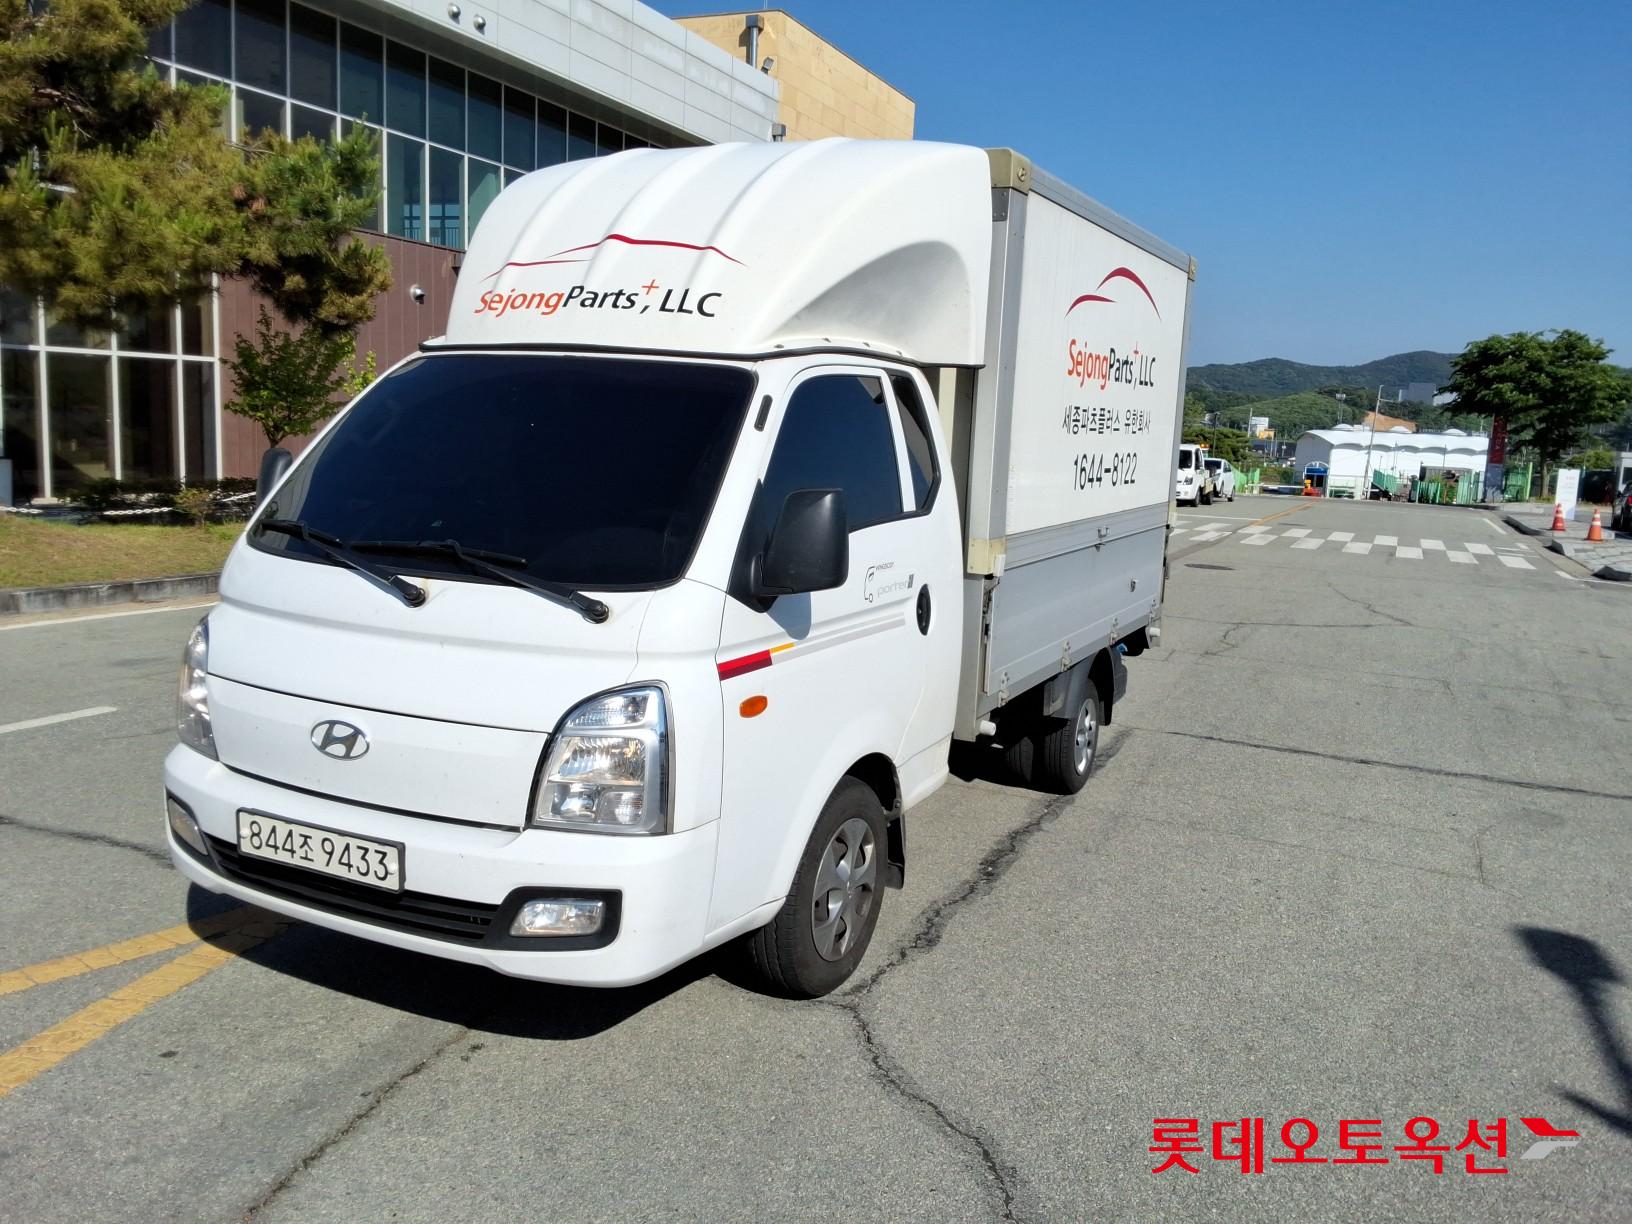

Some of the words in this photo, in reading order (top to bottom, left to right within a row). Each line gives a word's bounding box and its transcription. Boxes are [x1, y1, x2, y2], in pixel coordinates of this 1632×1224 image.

[658, 288, 722, 317] LLC
[1139, 354, 1156, 387] LLC
[1062, 405, 1120, 435] 세종파츠플러스
[1124, 409, 1151, 434] 유한회사
[1074, 452, 1138, 490] 1644-8122
[250, 820, 314, 862] 844조
[321, 837, 389, 881] 9433
